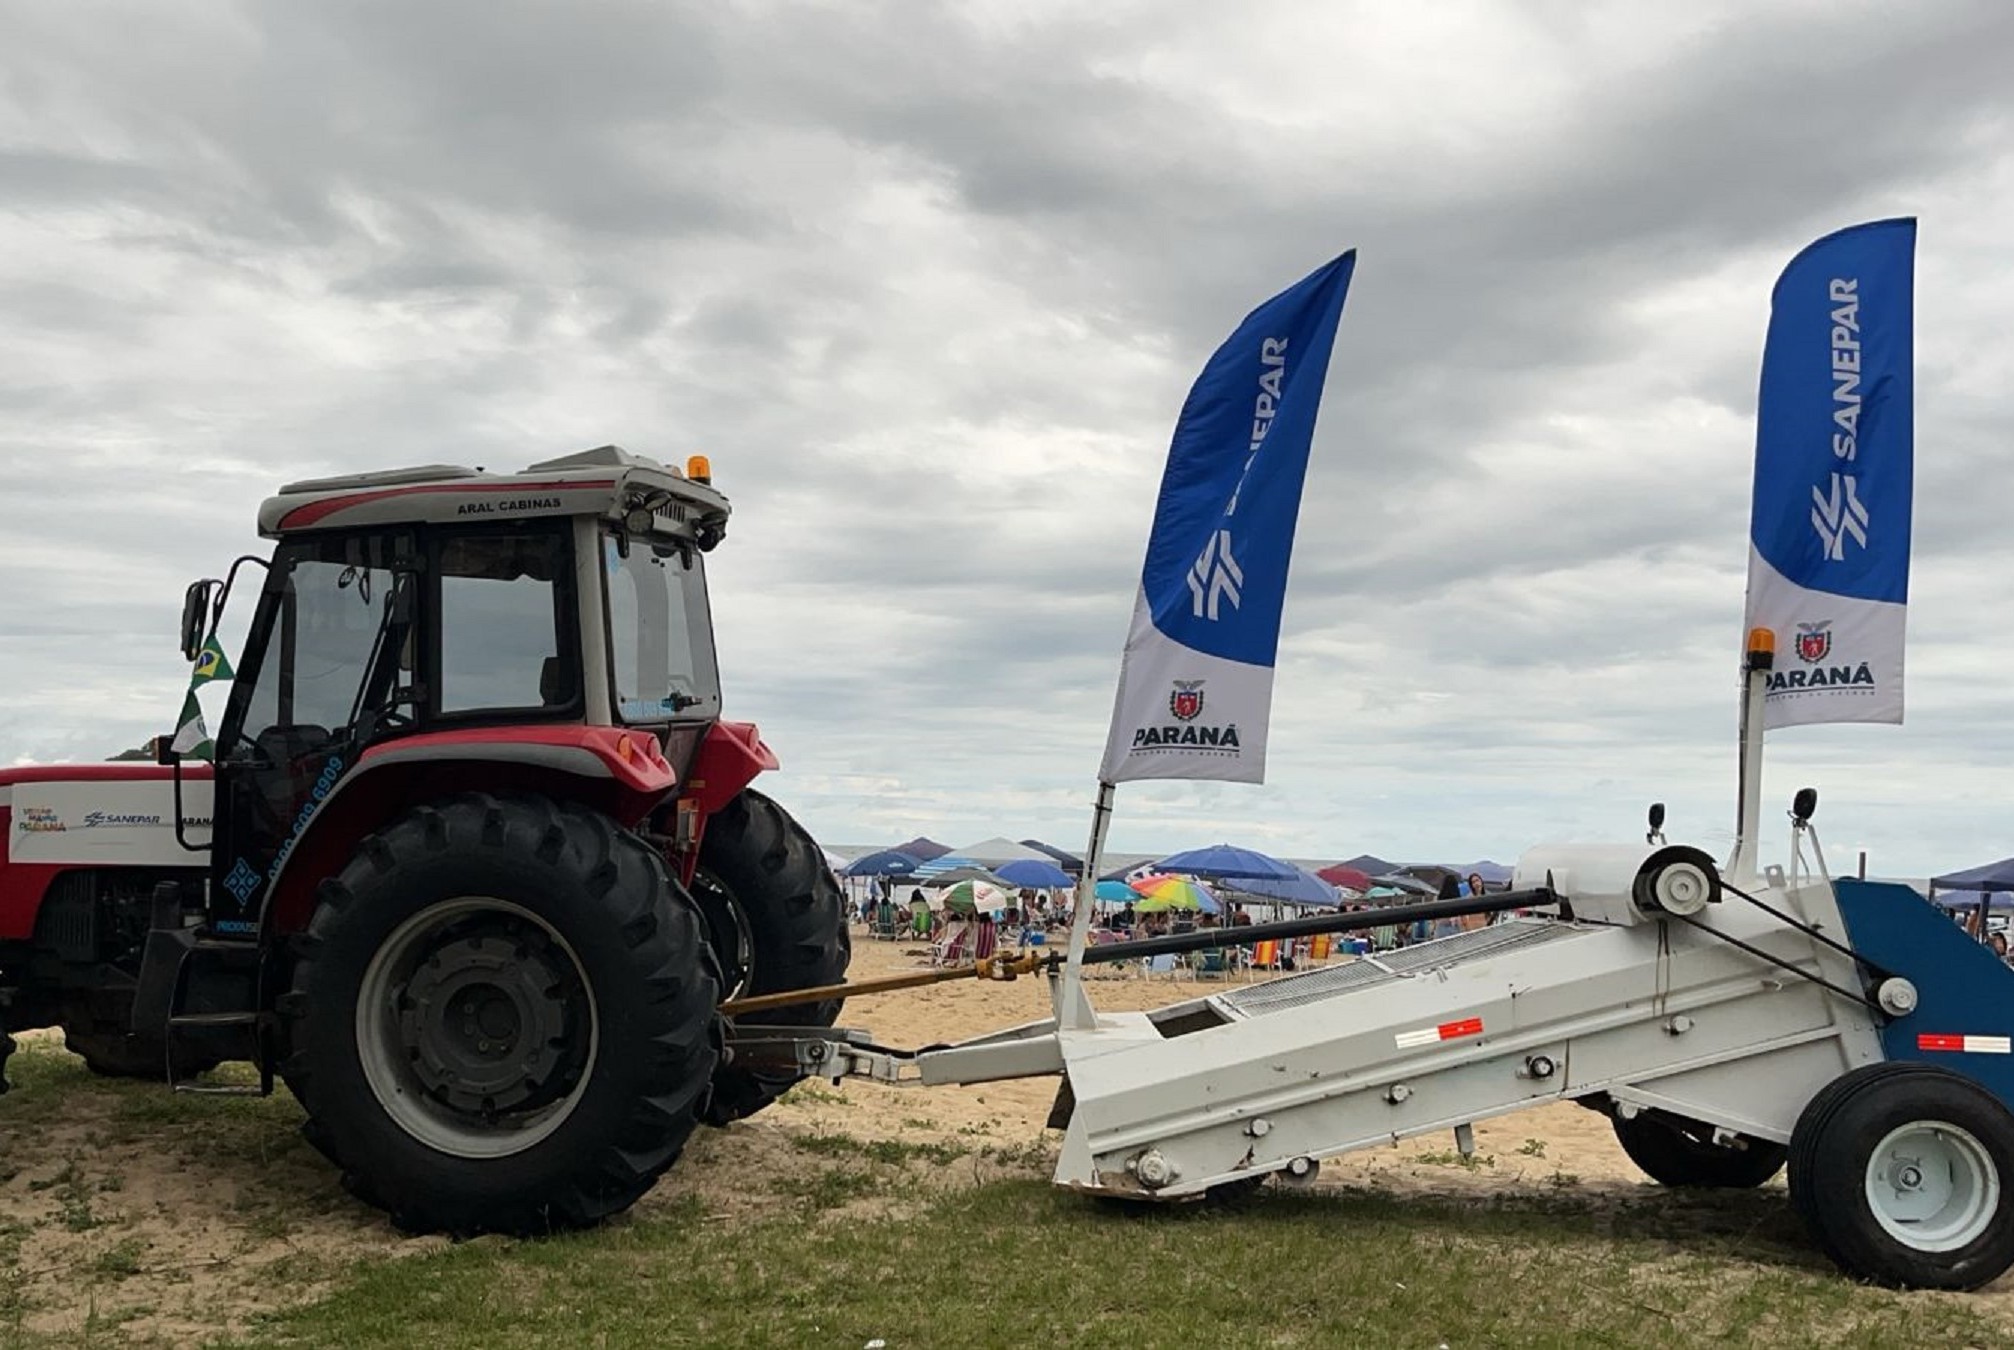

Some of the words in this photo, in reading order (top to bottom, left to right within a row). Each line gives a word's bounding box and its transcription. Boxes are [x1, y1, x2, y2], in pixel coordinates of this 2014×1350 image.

[1830, 278, 1861, 461] SANEPAR
[458, 503, 495, 515] ARAL
[498, 498, 561, 511] CABINAS
[1132, 724, 1240, 747] PARANÁ
[312, 756, 343, 800] 6909
[105, 815, 160, 824] SANEPAR
